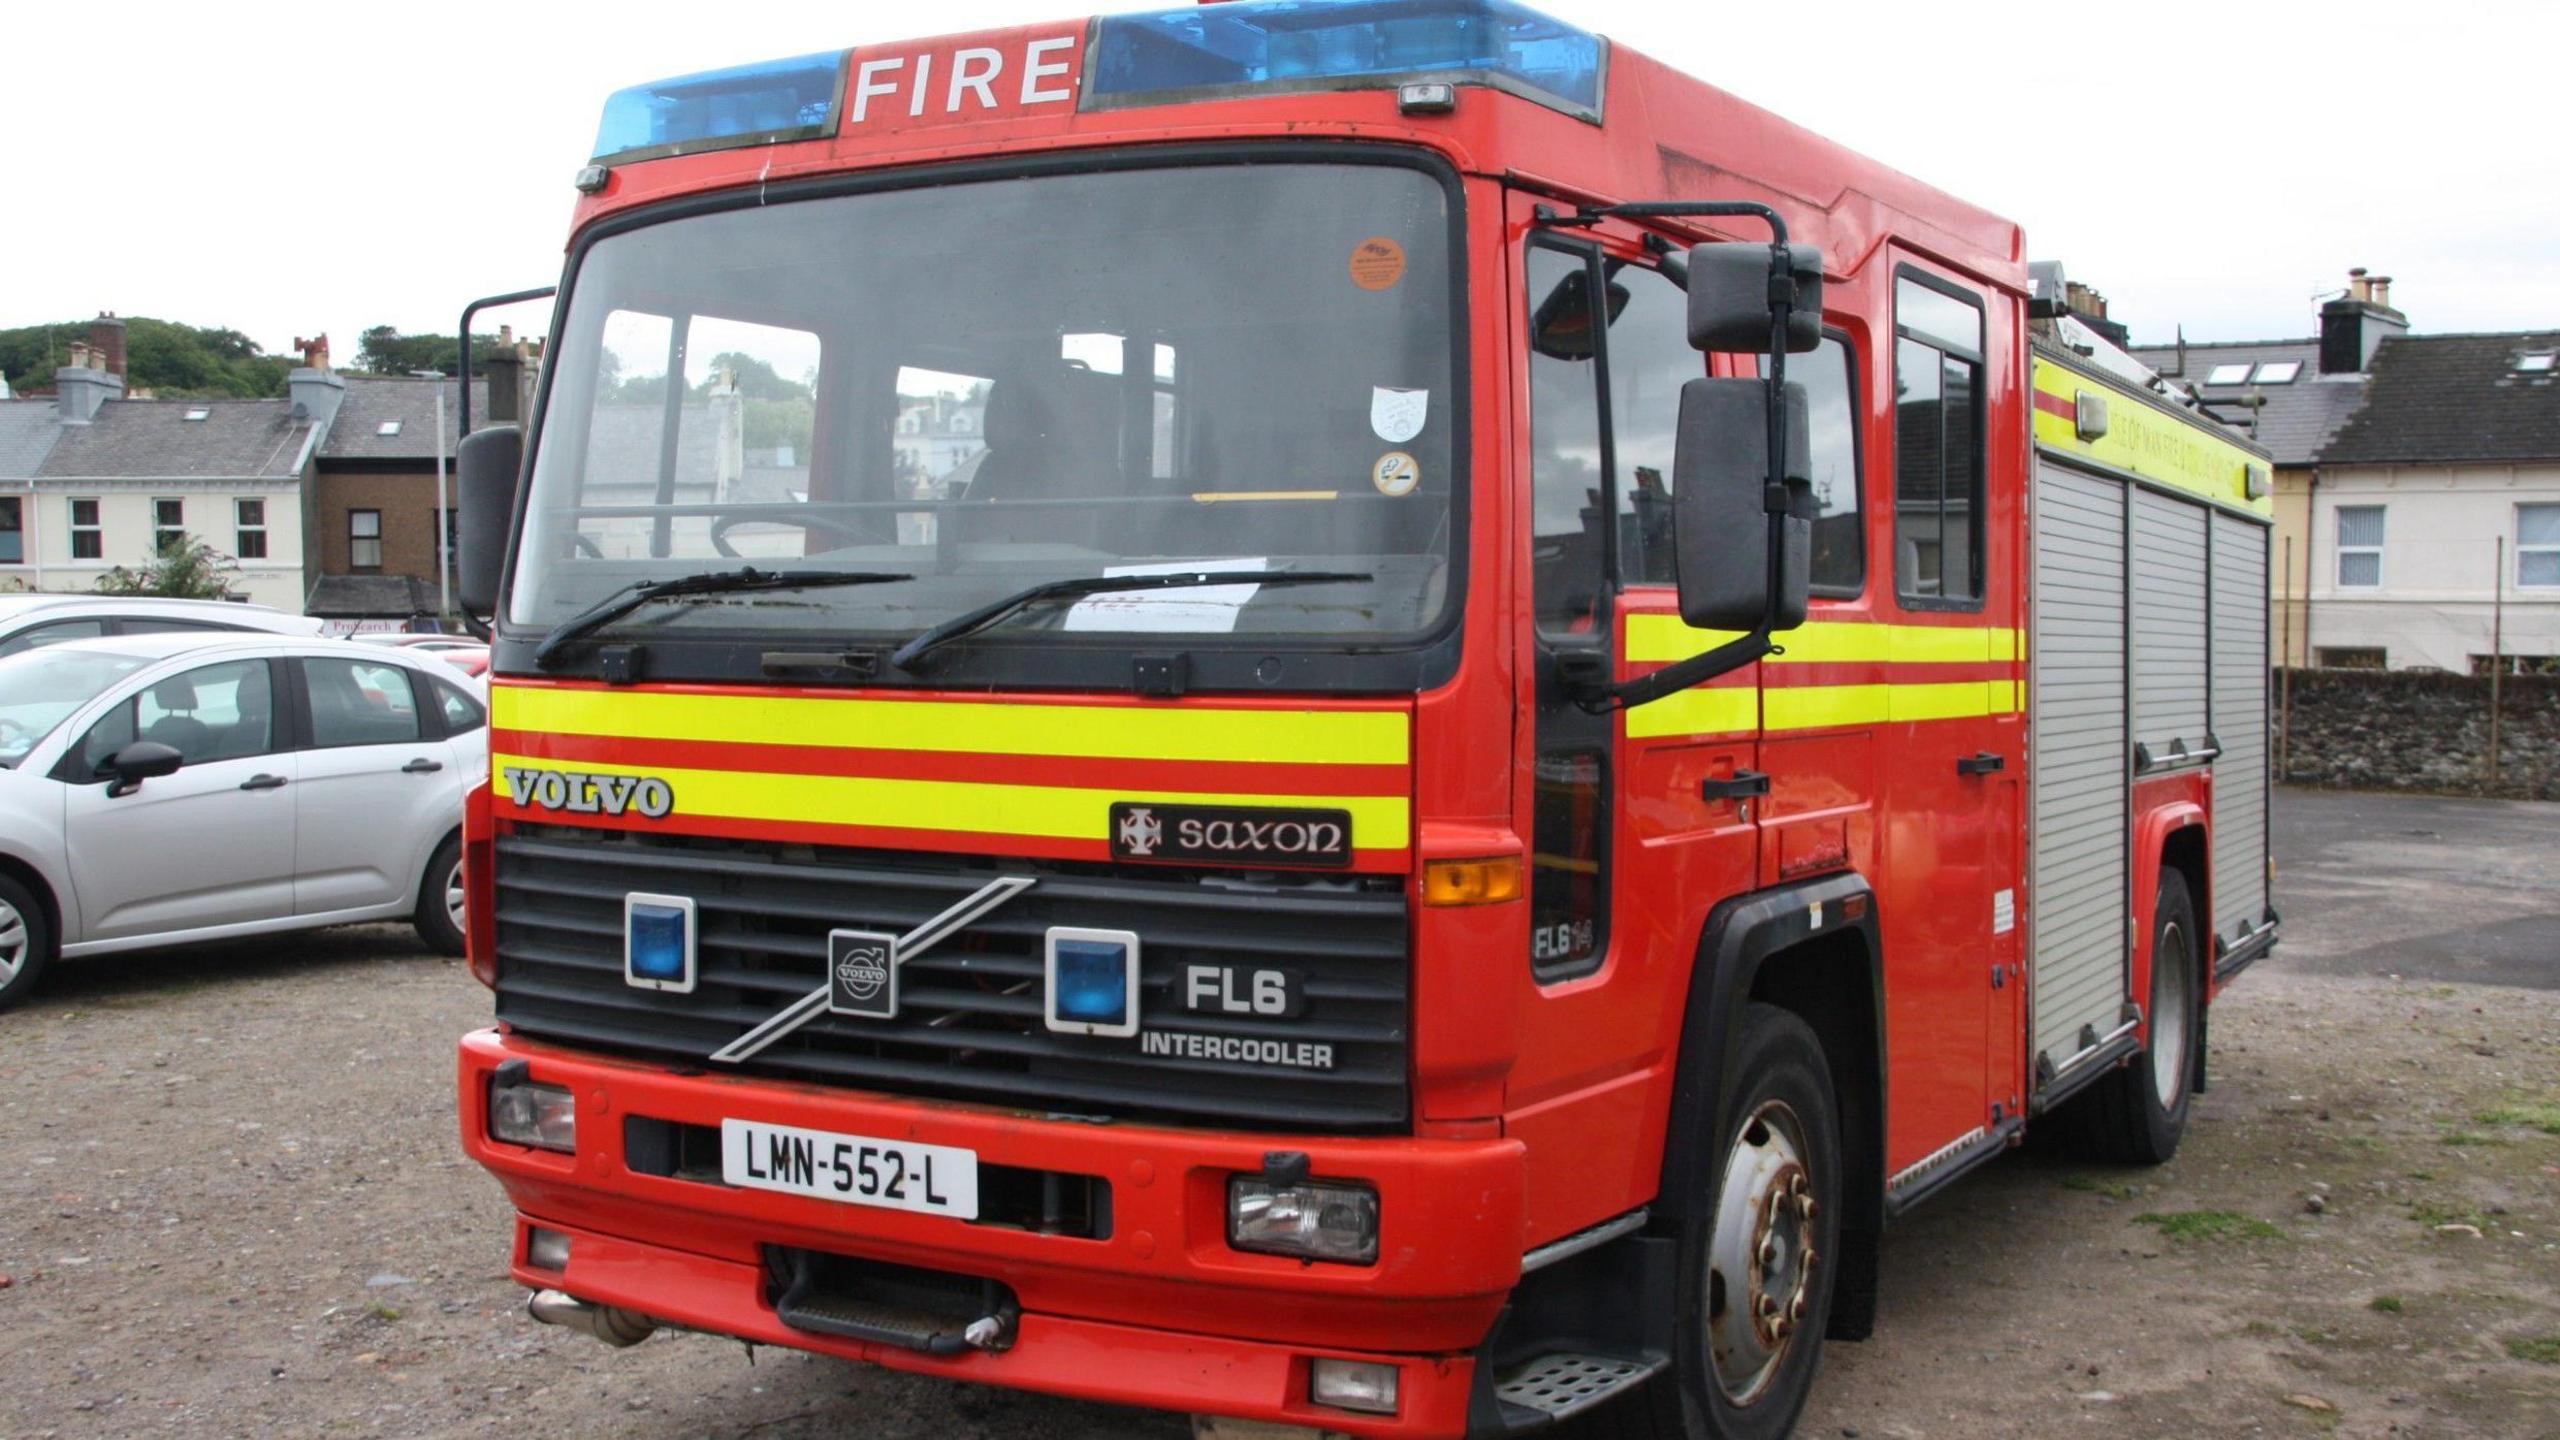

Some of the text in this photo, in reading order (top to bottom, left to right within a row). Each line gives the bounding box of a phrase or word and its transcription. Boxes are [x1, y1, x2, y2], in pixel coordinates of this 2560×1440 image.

[851, 36, 1075, 123] FIRE
[503, 767, 674, 819] VOLVO
[840, 966, 884, 981] VOLVO
[1187, 965, 1286, 1015] FL6
[1141, 1031, 1333, 1068] INTERCOOLER
[747, 1130, 947, 1205] LMN-552-L
